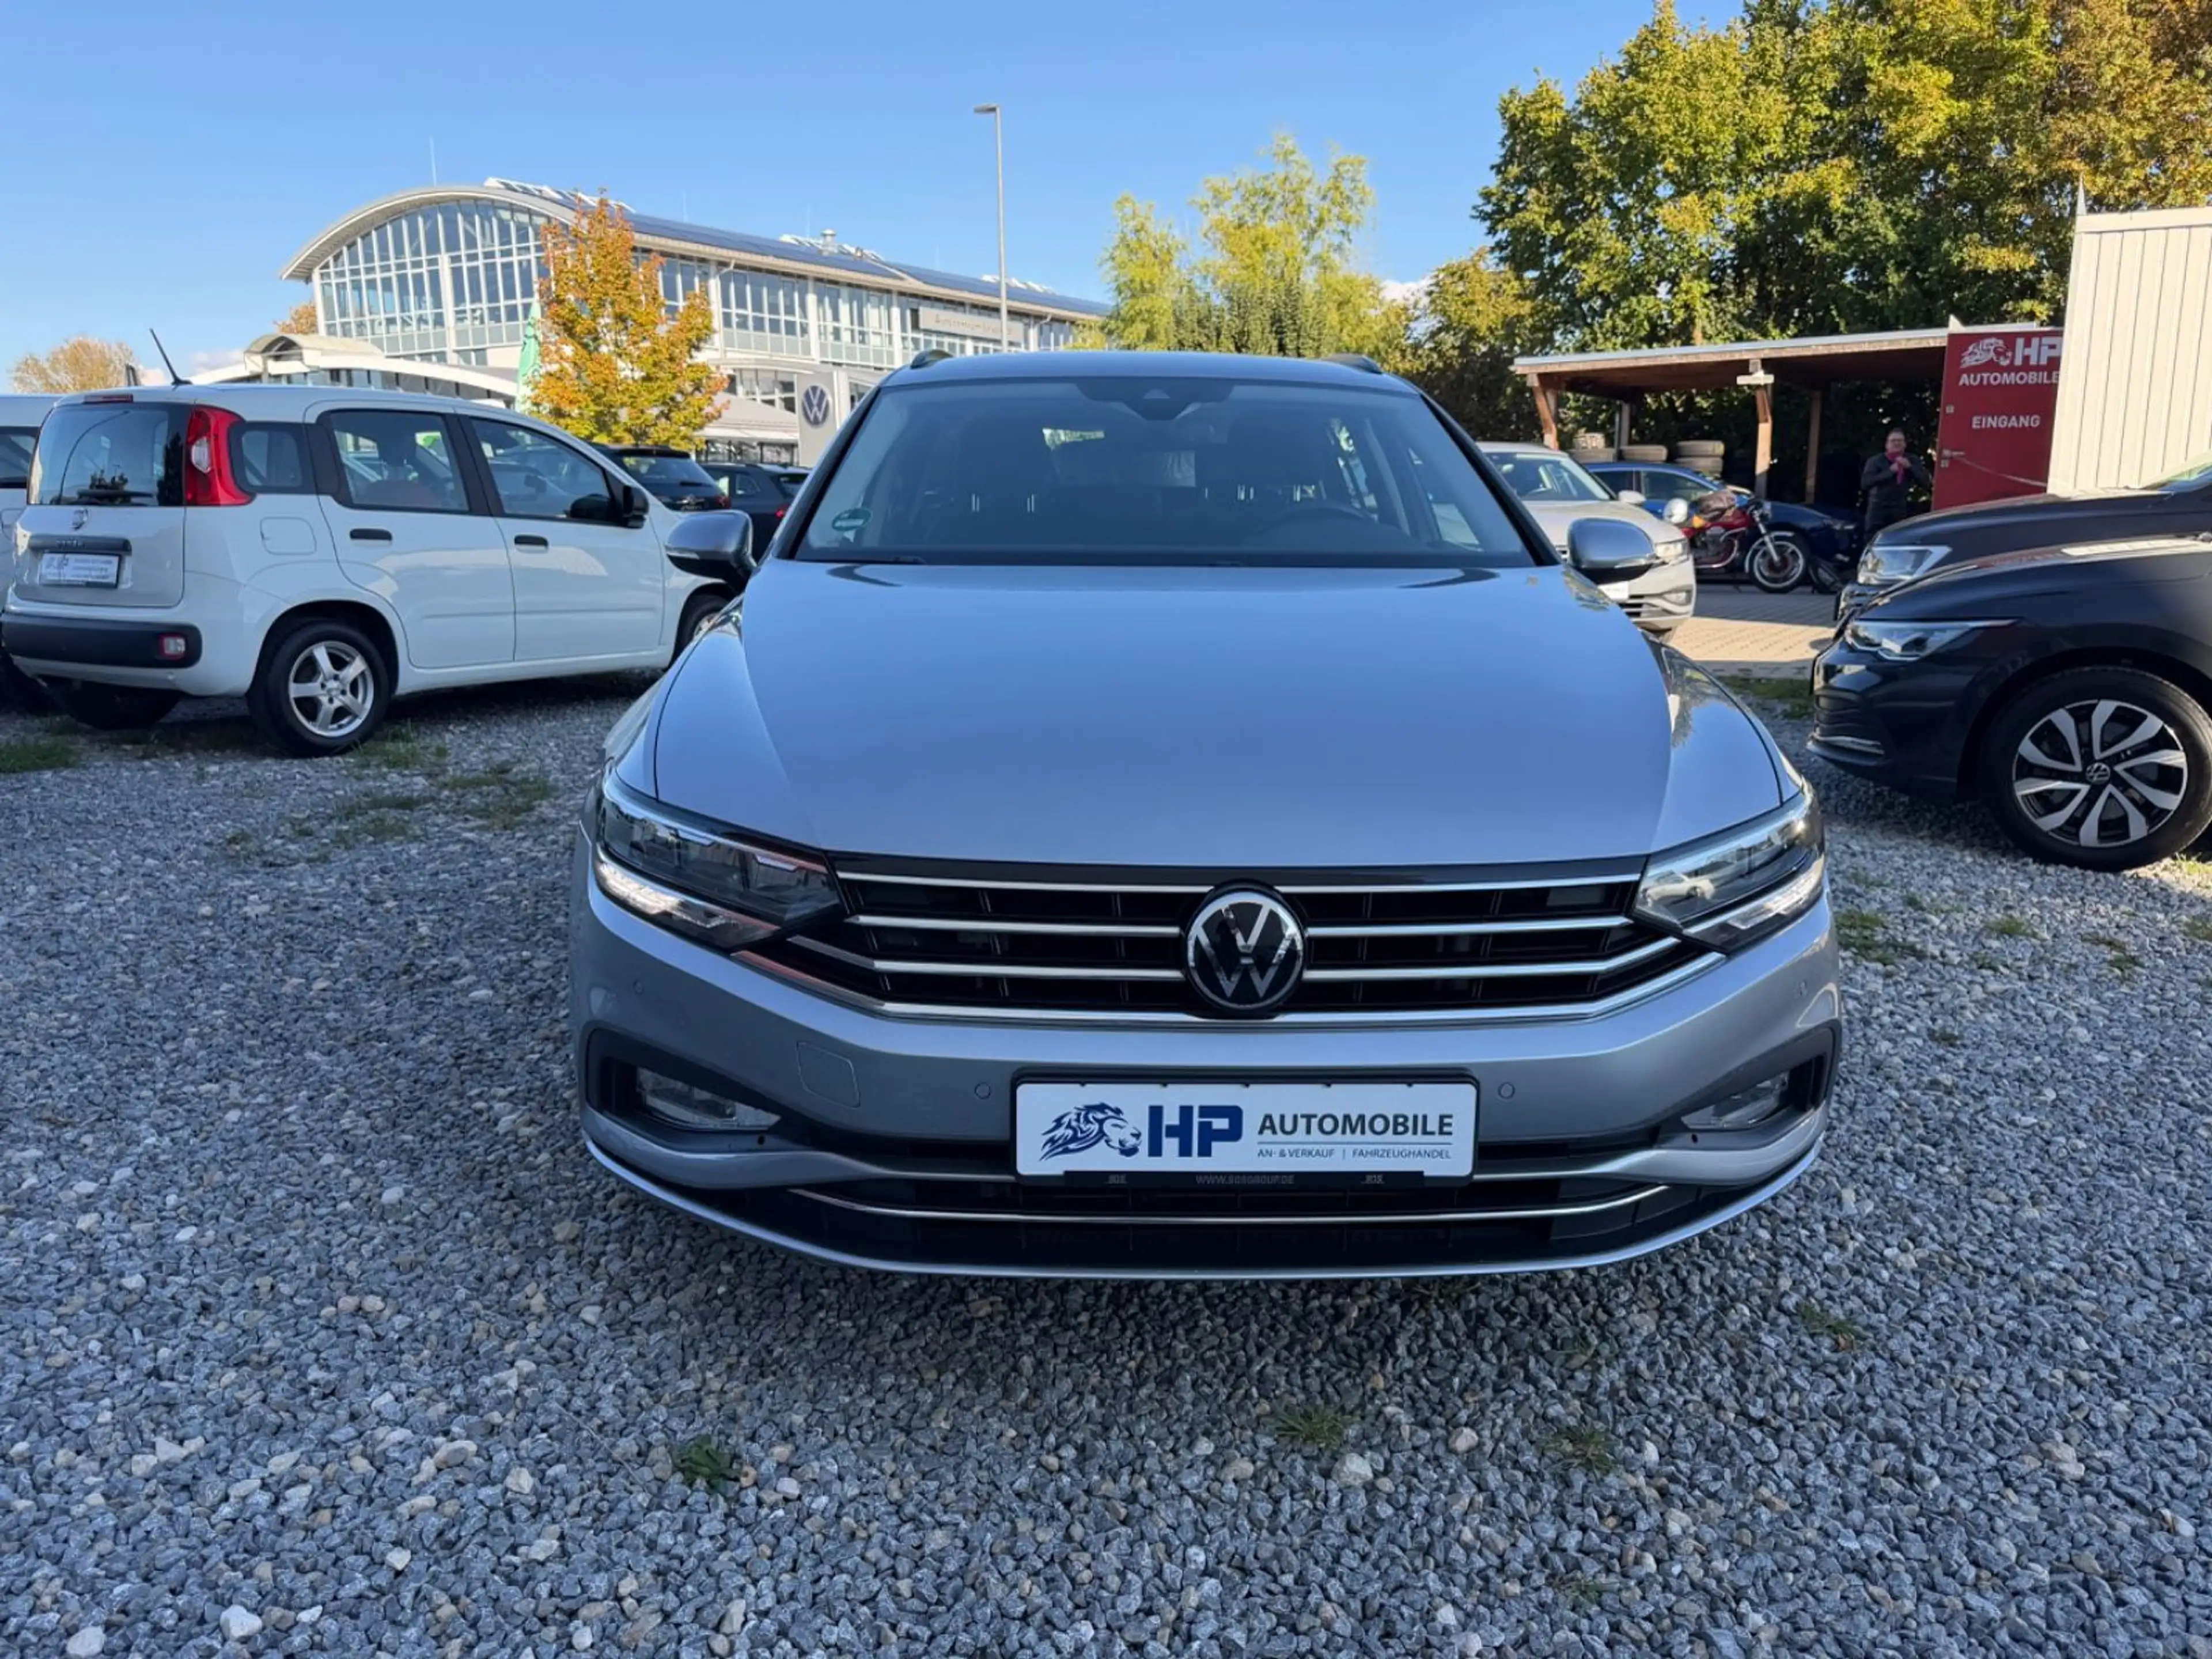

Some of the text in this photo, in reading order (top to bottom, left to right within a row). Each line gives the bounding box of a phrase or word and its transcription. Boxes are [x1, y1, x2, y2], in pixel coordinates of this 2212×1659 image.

[2014, 337, 2064, 366] HP
[1959, 371, 2060, 387] AUTOMOBILE
[1971, 415, 2040, 429] EINGANG
[1147, 1105, 1453, 1157] HP AUTOMOBILE
[1288, 1149, 1335, 1158] VERKAUF
[1352, 1149, 1452, 1159] FAHRZEUGHANDEL
